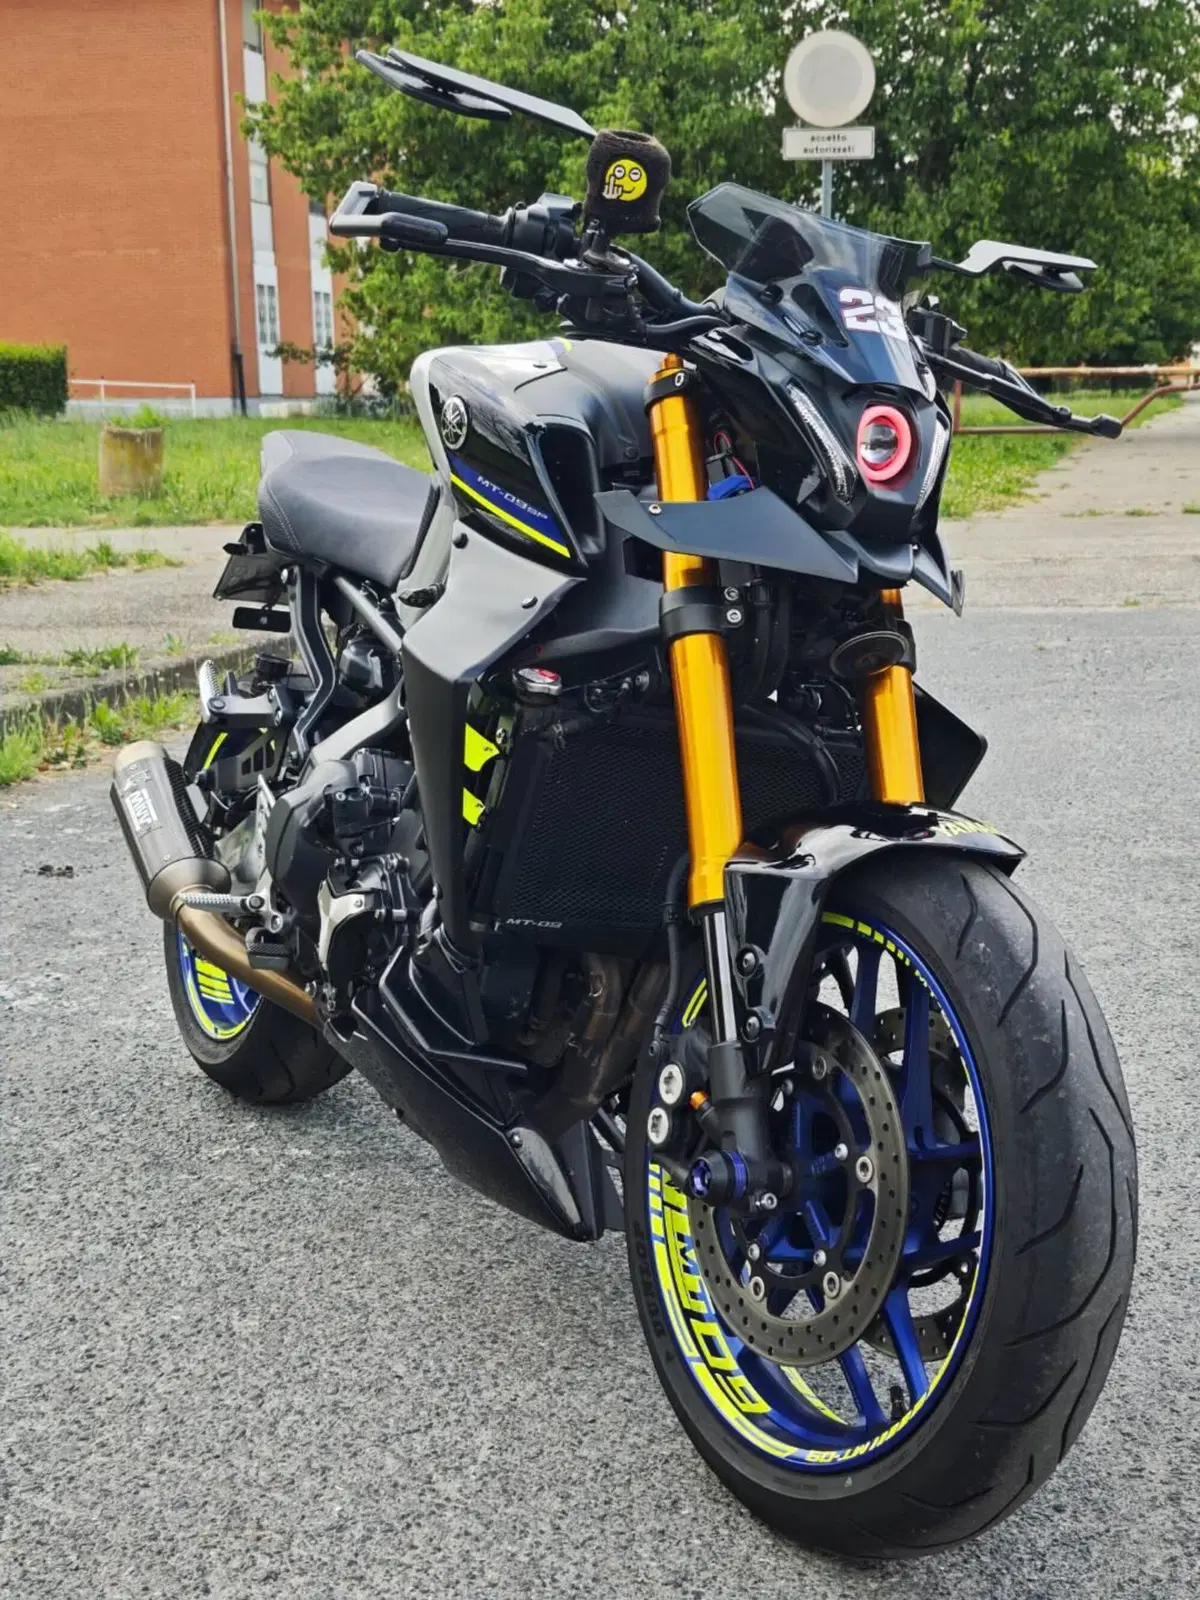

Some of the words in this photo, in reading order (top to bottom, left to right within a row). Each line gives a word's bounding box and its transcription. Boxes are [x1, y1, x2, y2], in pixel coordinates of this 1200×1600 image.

[811, 133, 847, 142] eccetto
[803, 145, 855, 154] autorizzati
[506, 918, 562, 928] MT-09
